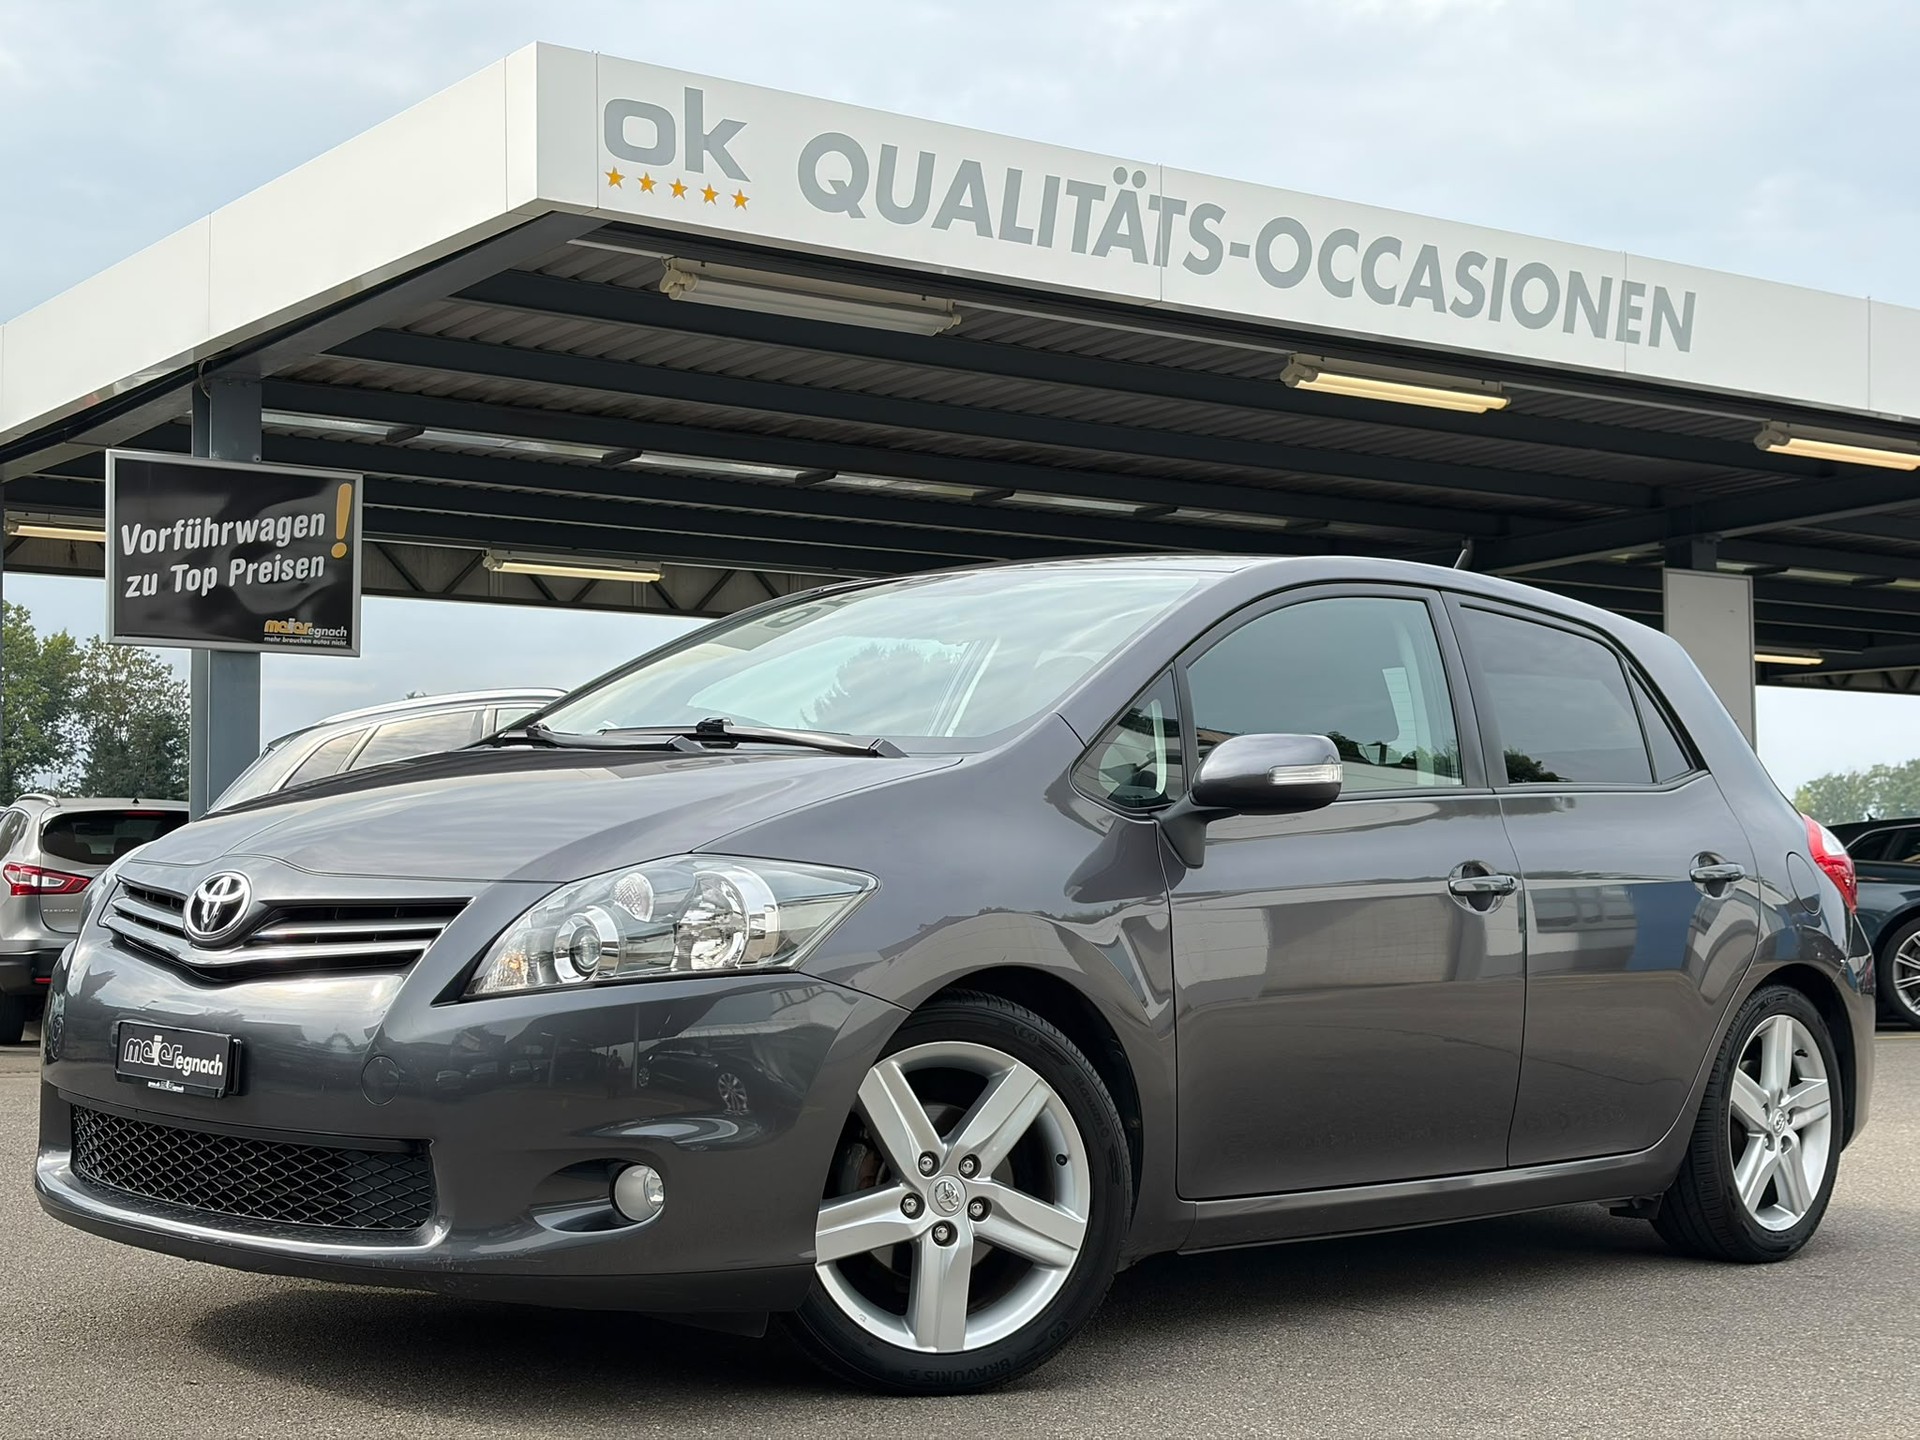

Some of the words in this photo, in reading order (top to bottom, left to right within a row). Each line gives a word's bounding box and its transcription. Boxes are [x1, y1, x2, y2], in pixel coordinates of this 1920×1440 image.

[604, 87, 750, 183] ok
[797, 131, 1697, 353] QUALITÄTS-OCCASIONEN
[121, 512, 326, 557] Vorführwagen
[124, 572, 158, 599] zu
[169, 563, 218, 597] Top
[228, 553, 325, 587] Preisen
